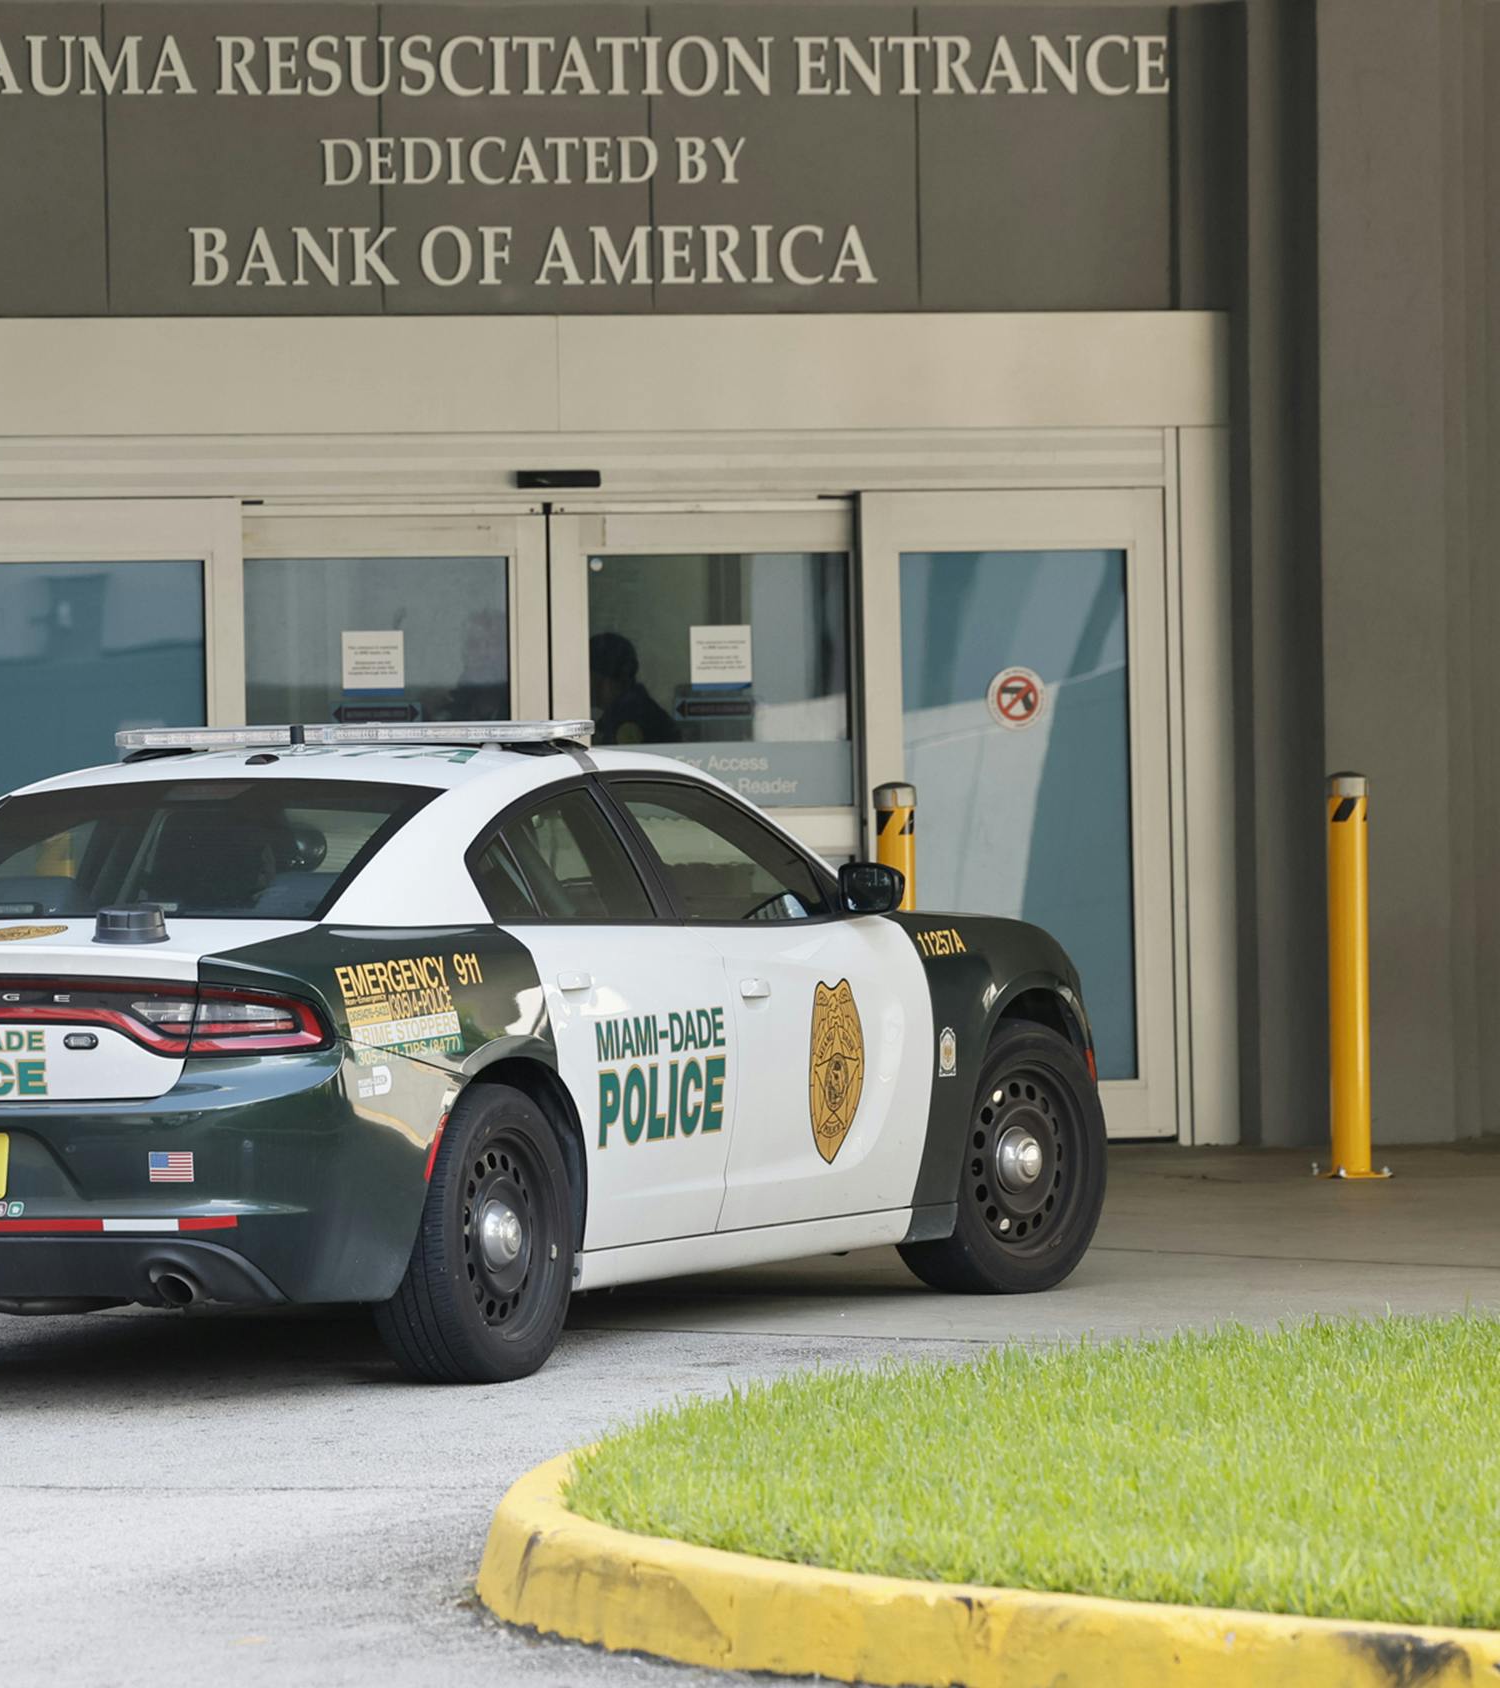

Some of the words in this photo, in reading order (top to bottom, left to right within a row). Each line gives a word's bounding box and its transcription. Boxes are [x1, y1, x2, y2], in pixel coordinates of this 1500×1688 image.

[215, 34, 774, 97] RESUSCITATION
[794, 33, 1169, 95] ENTRANCE
[321, 136, 658, 186] DEDICATED
[675, 136, 746, 185] BY
[188, 226, 399, 288] BANK
[420, 224, 513, 287] OF
[535, 224, 878, 286] AMERICA
[707, 755, 769, 772] Access
[737, 777, 798, 794] Reader
[916, 928, 966, 957] 11257A
[334, 956, 447, 997] EMERGENCY
[453, 953, 483, 985] 911
[352, 1023, 394, 1049] CRIME
[396, 1013, 461, 1043] STOPPERS
[429, 1036, 462, 1056] (8477)
[594, 1006, 727, 1063] MIAMI-DADE
[596, 1054, 727, 1150] POLICE
